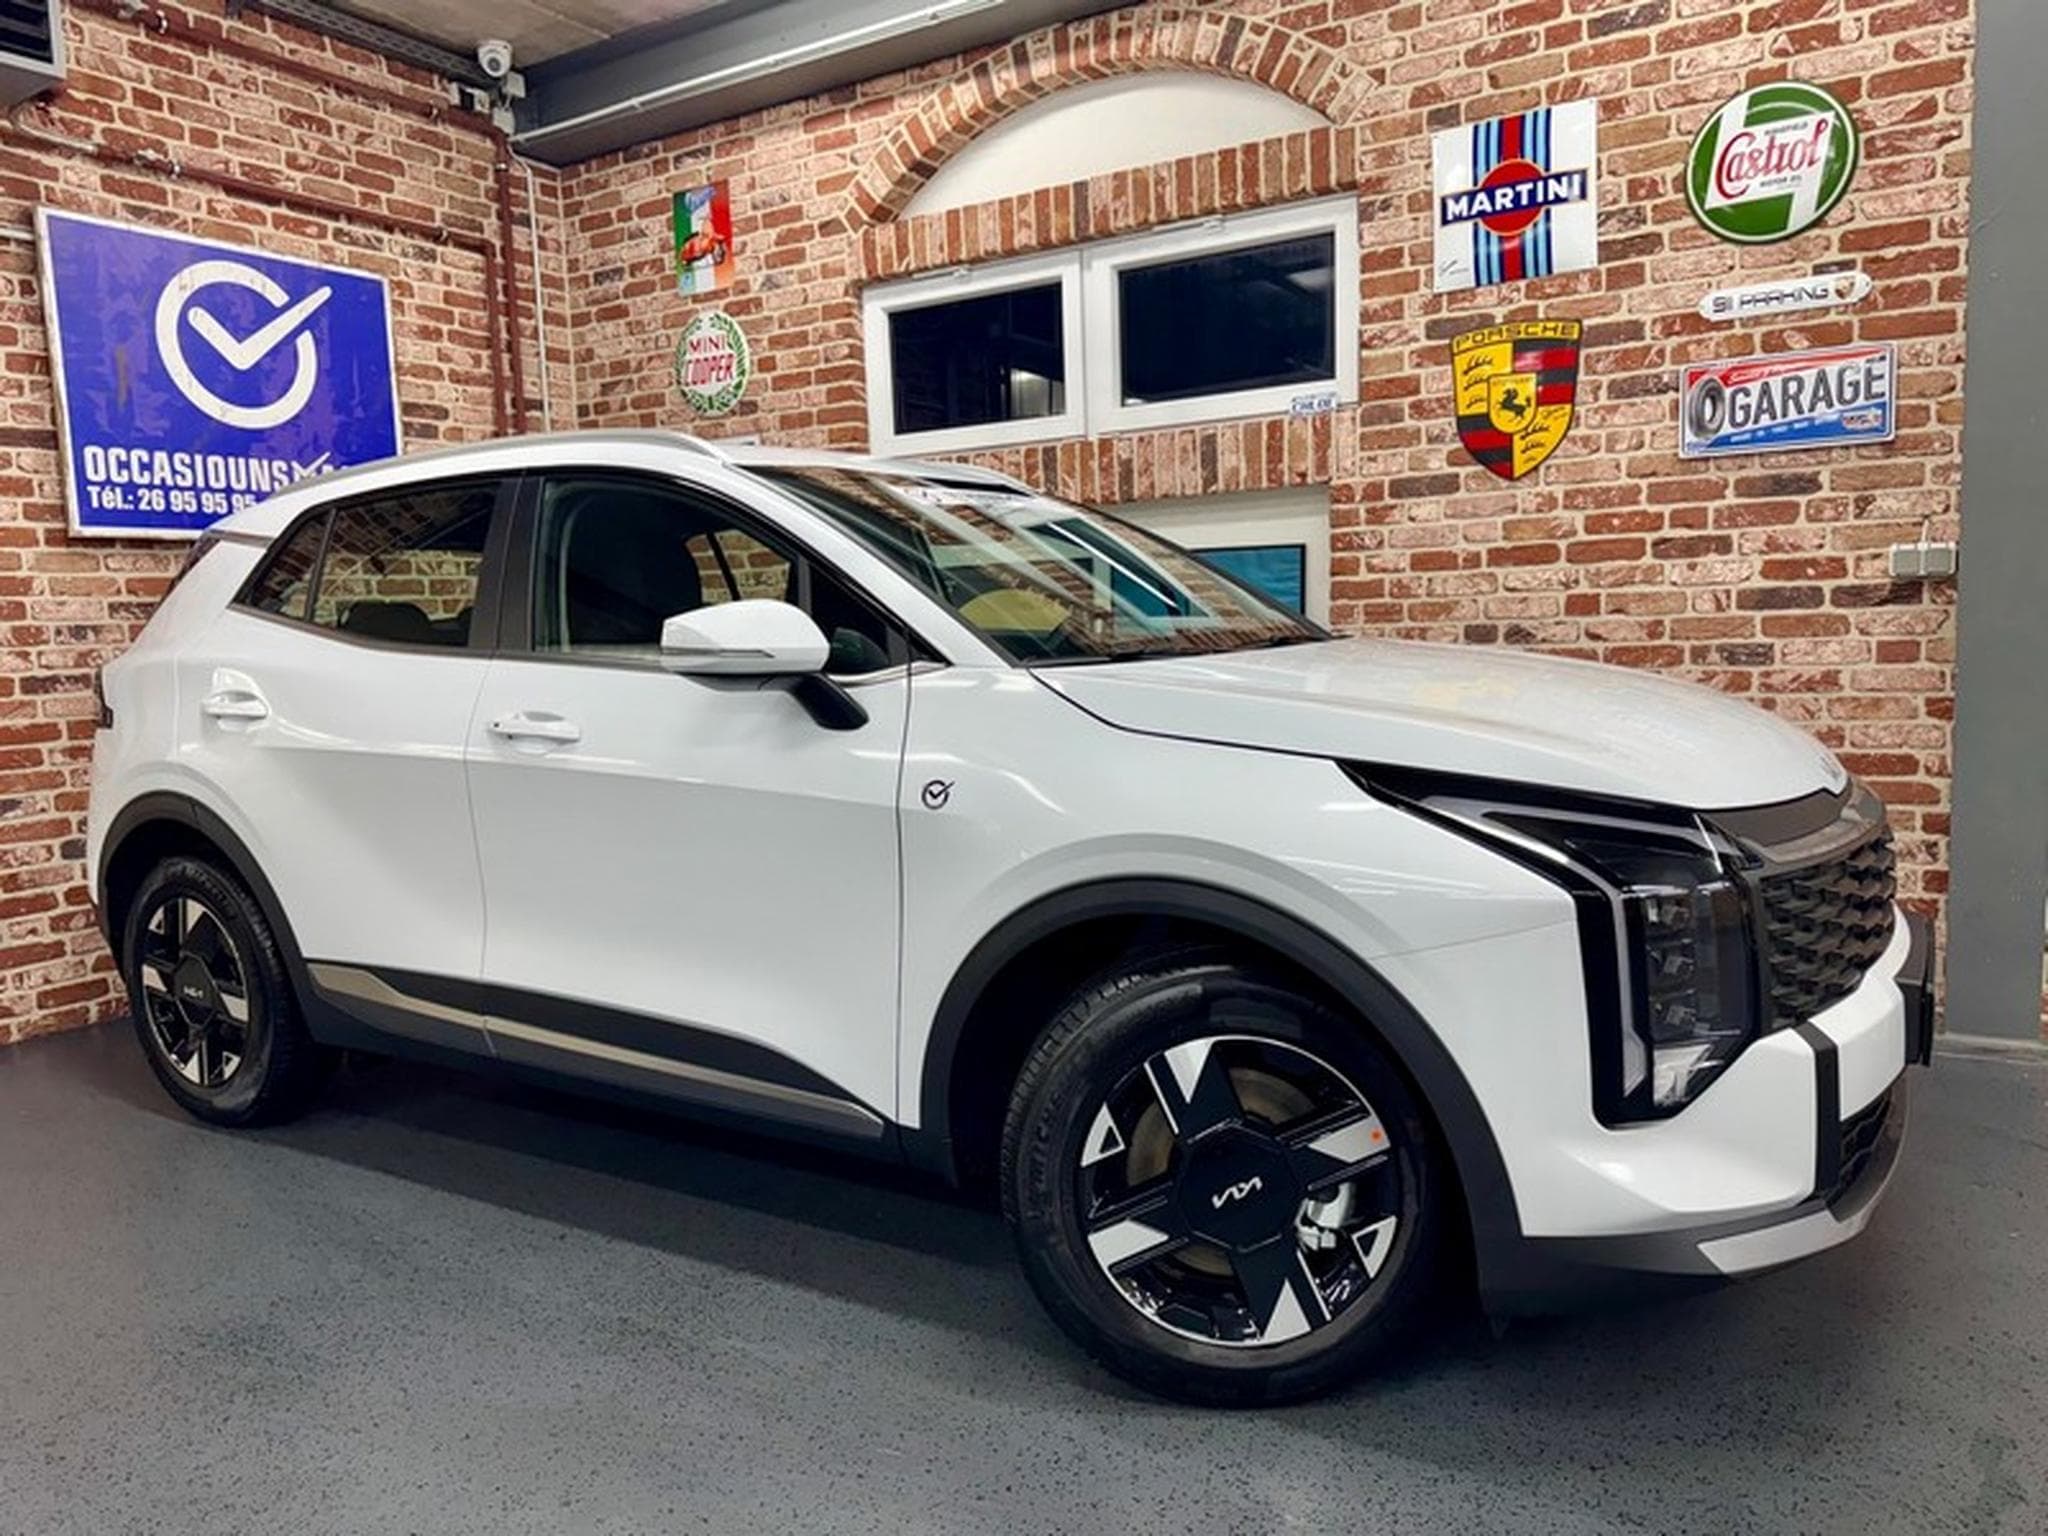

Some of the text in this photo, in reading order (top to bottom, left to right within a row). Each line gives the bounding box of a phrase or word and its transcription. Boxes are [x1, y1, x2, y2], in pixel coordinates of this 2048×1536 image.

[1715, 118, 1829, 200] Castrol
[1446, 173, 1582, 221] MARTINI
[1740, 286, 1829, 309] PARKING
[688, 334, 726, 353] MINI
[1455, 323, 1577, 349] PORSCHE
[685, 353, 734, 387] COOPER
[137, 489, 165, 511] 26
[169, 491, 197, 514] 95
[200, 493, 229, 515] 95
